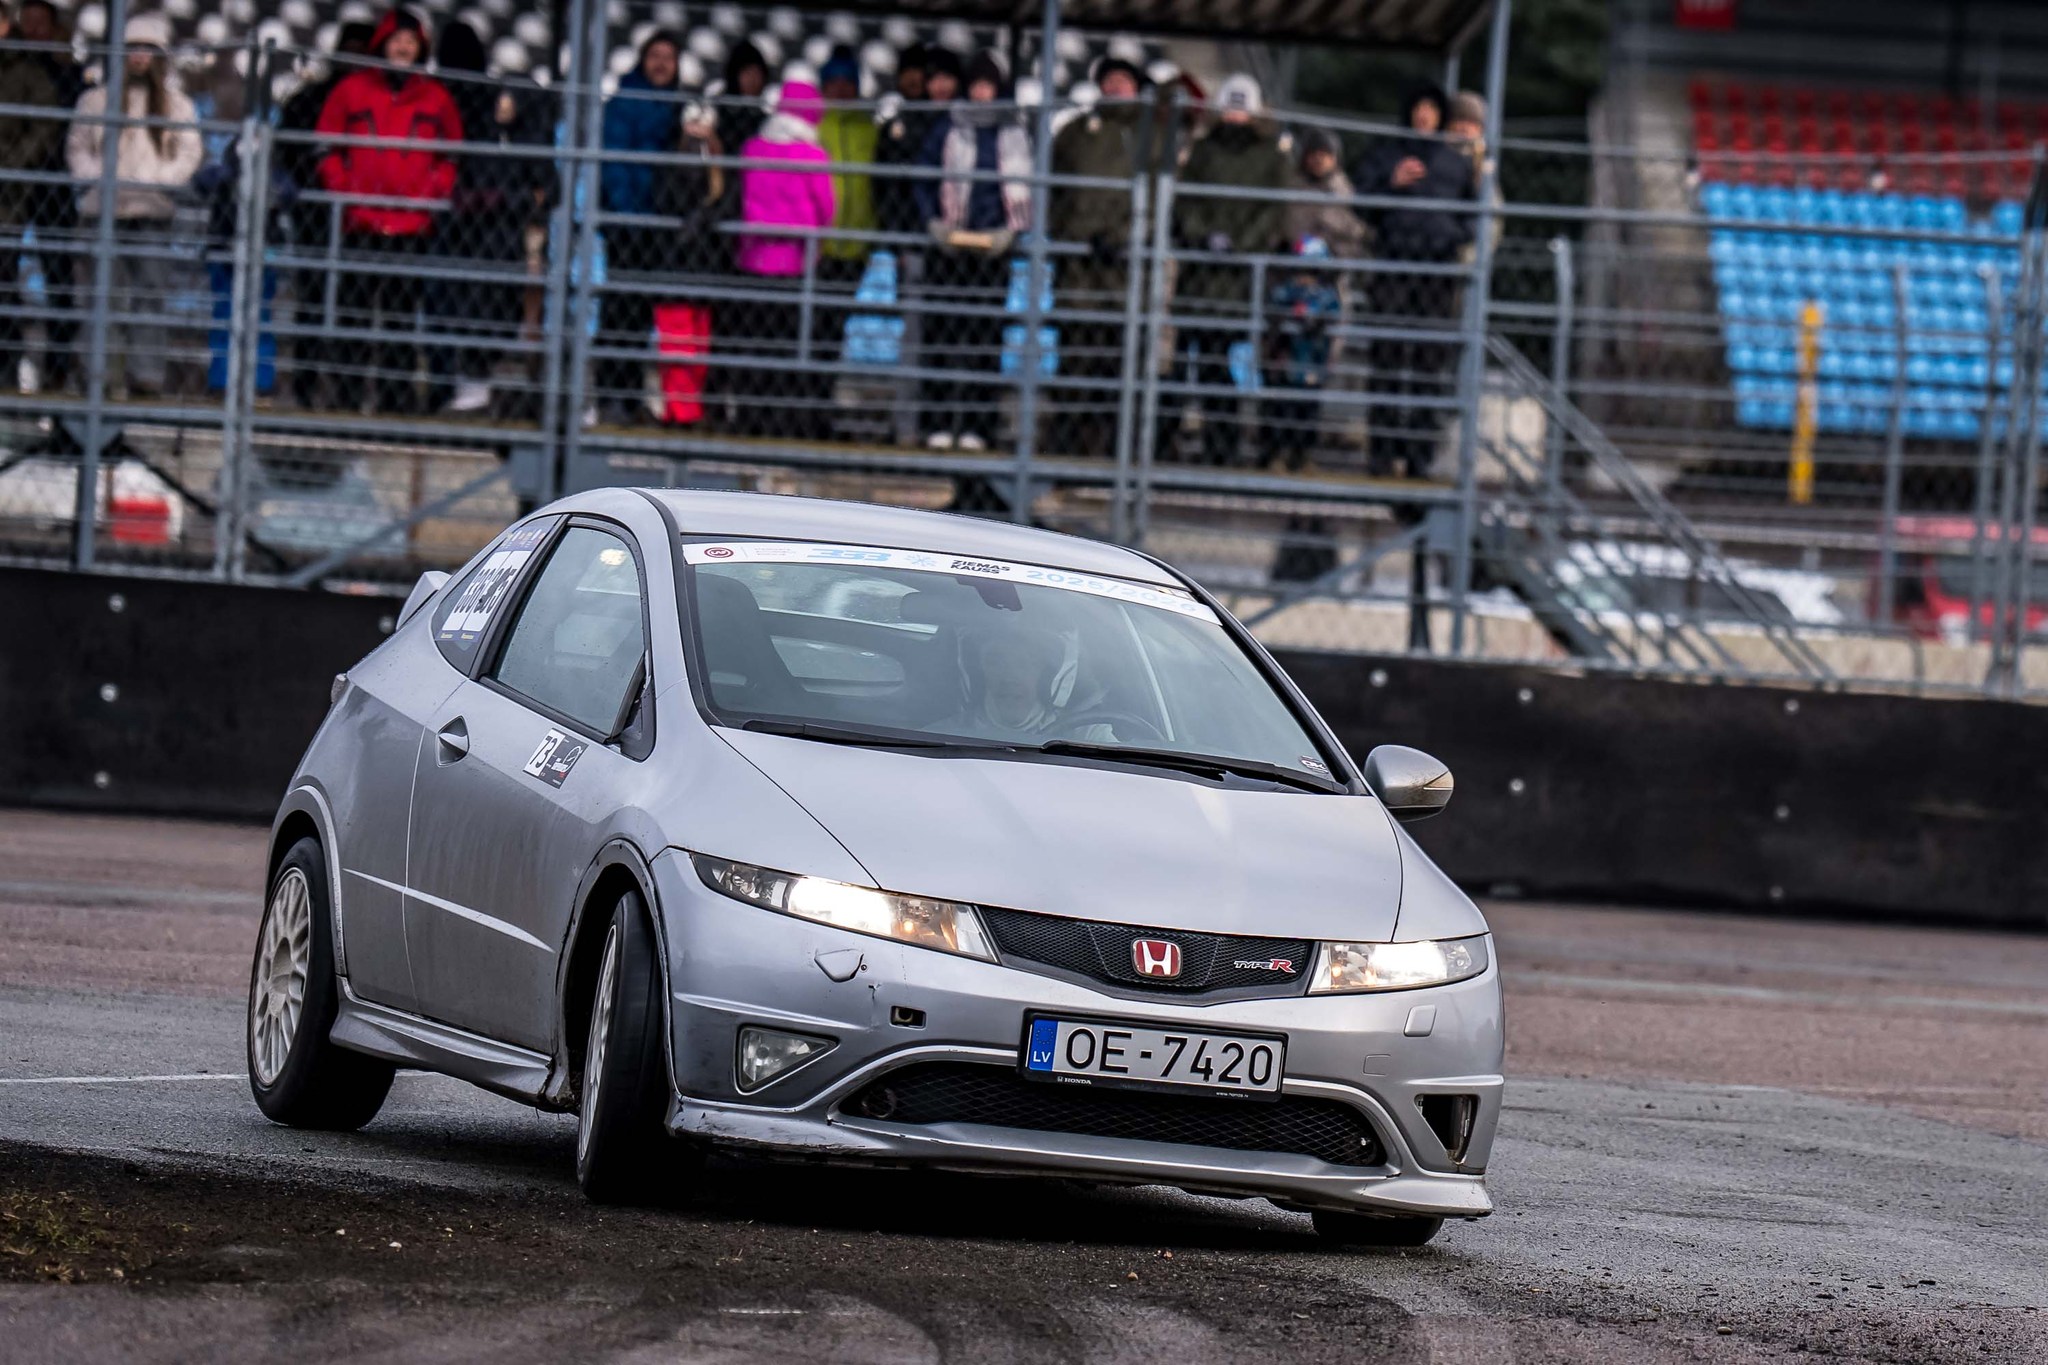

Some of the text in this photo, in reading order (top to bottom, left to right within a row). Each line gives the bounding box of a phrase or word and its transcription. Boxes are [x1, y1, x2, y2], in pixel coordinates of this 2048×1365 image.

[950, 565, 1000, 574] KAUSS
[953, 560, 1010, 571] ZIEMAS
[1026, 570, 1197, 612] 2025/2026
[529, 735, 558, 768] 73
[1032, 1050, 1052, 1064] LV
[1065, 1027, 1274, 1086] OE-7420
[1064, 1077, 1092, 1085] HONDA
